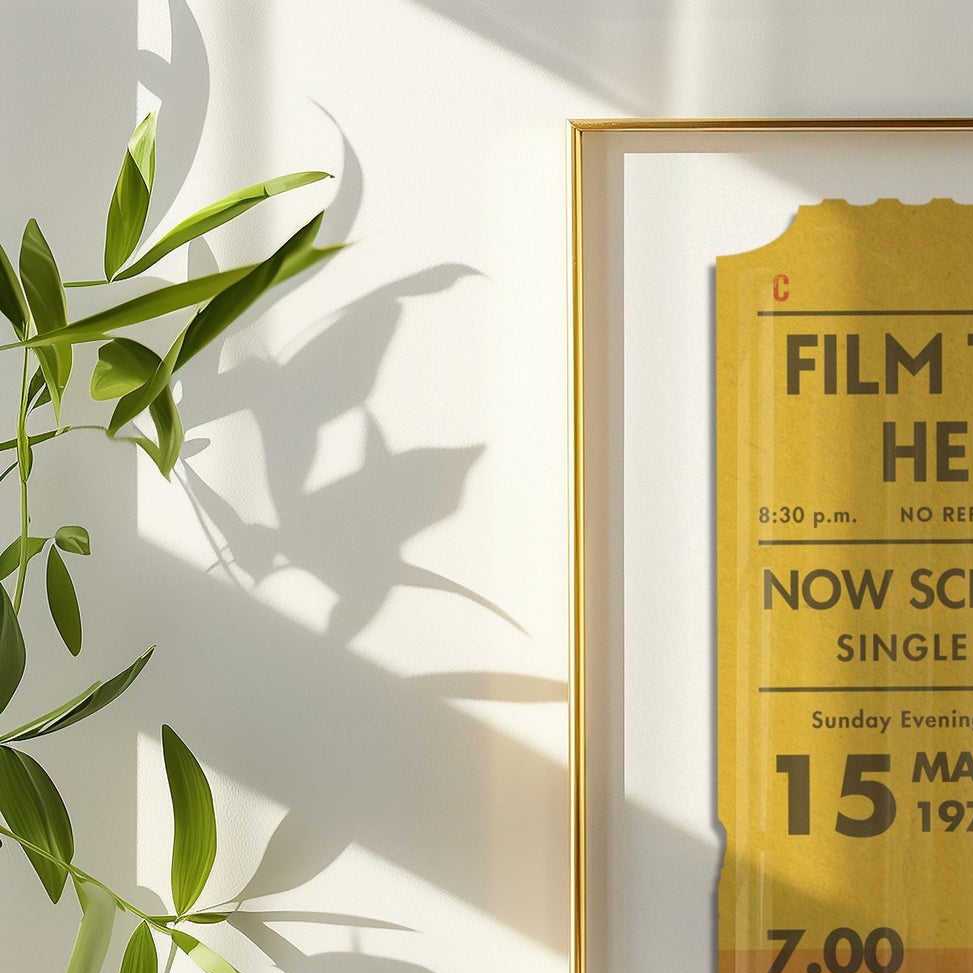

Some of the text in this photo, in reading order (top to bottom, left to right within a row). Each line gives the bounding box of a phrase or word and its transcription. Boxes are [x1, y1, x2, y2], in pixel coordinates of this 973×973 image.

[773, 275, 789, 302] C
[787, 333, 942, 395] FILM
[760, 507, 856, 528] 8:30 p.m.
[901, 507, 932, 522] NO
[765, 569, 894, 610] NOW
[838, 634, 966, 662] SINGLE
[813, 709, 890, 733] Sunday
[776, 754, 897, 838] 15
